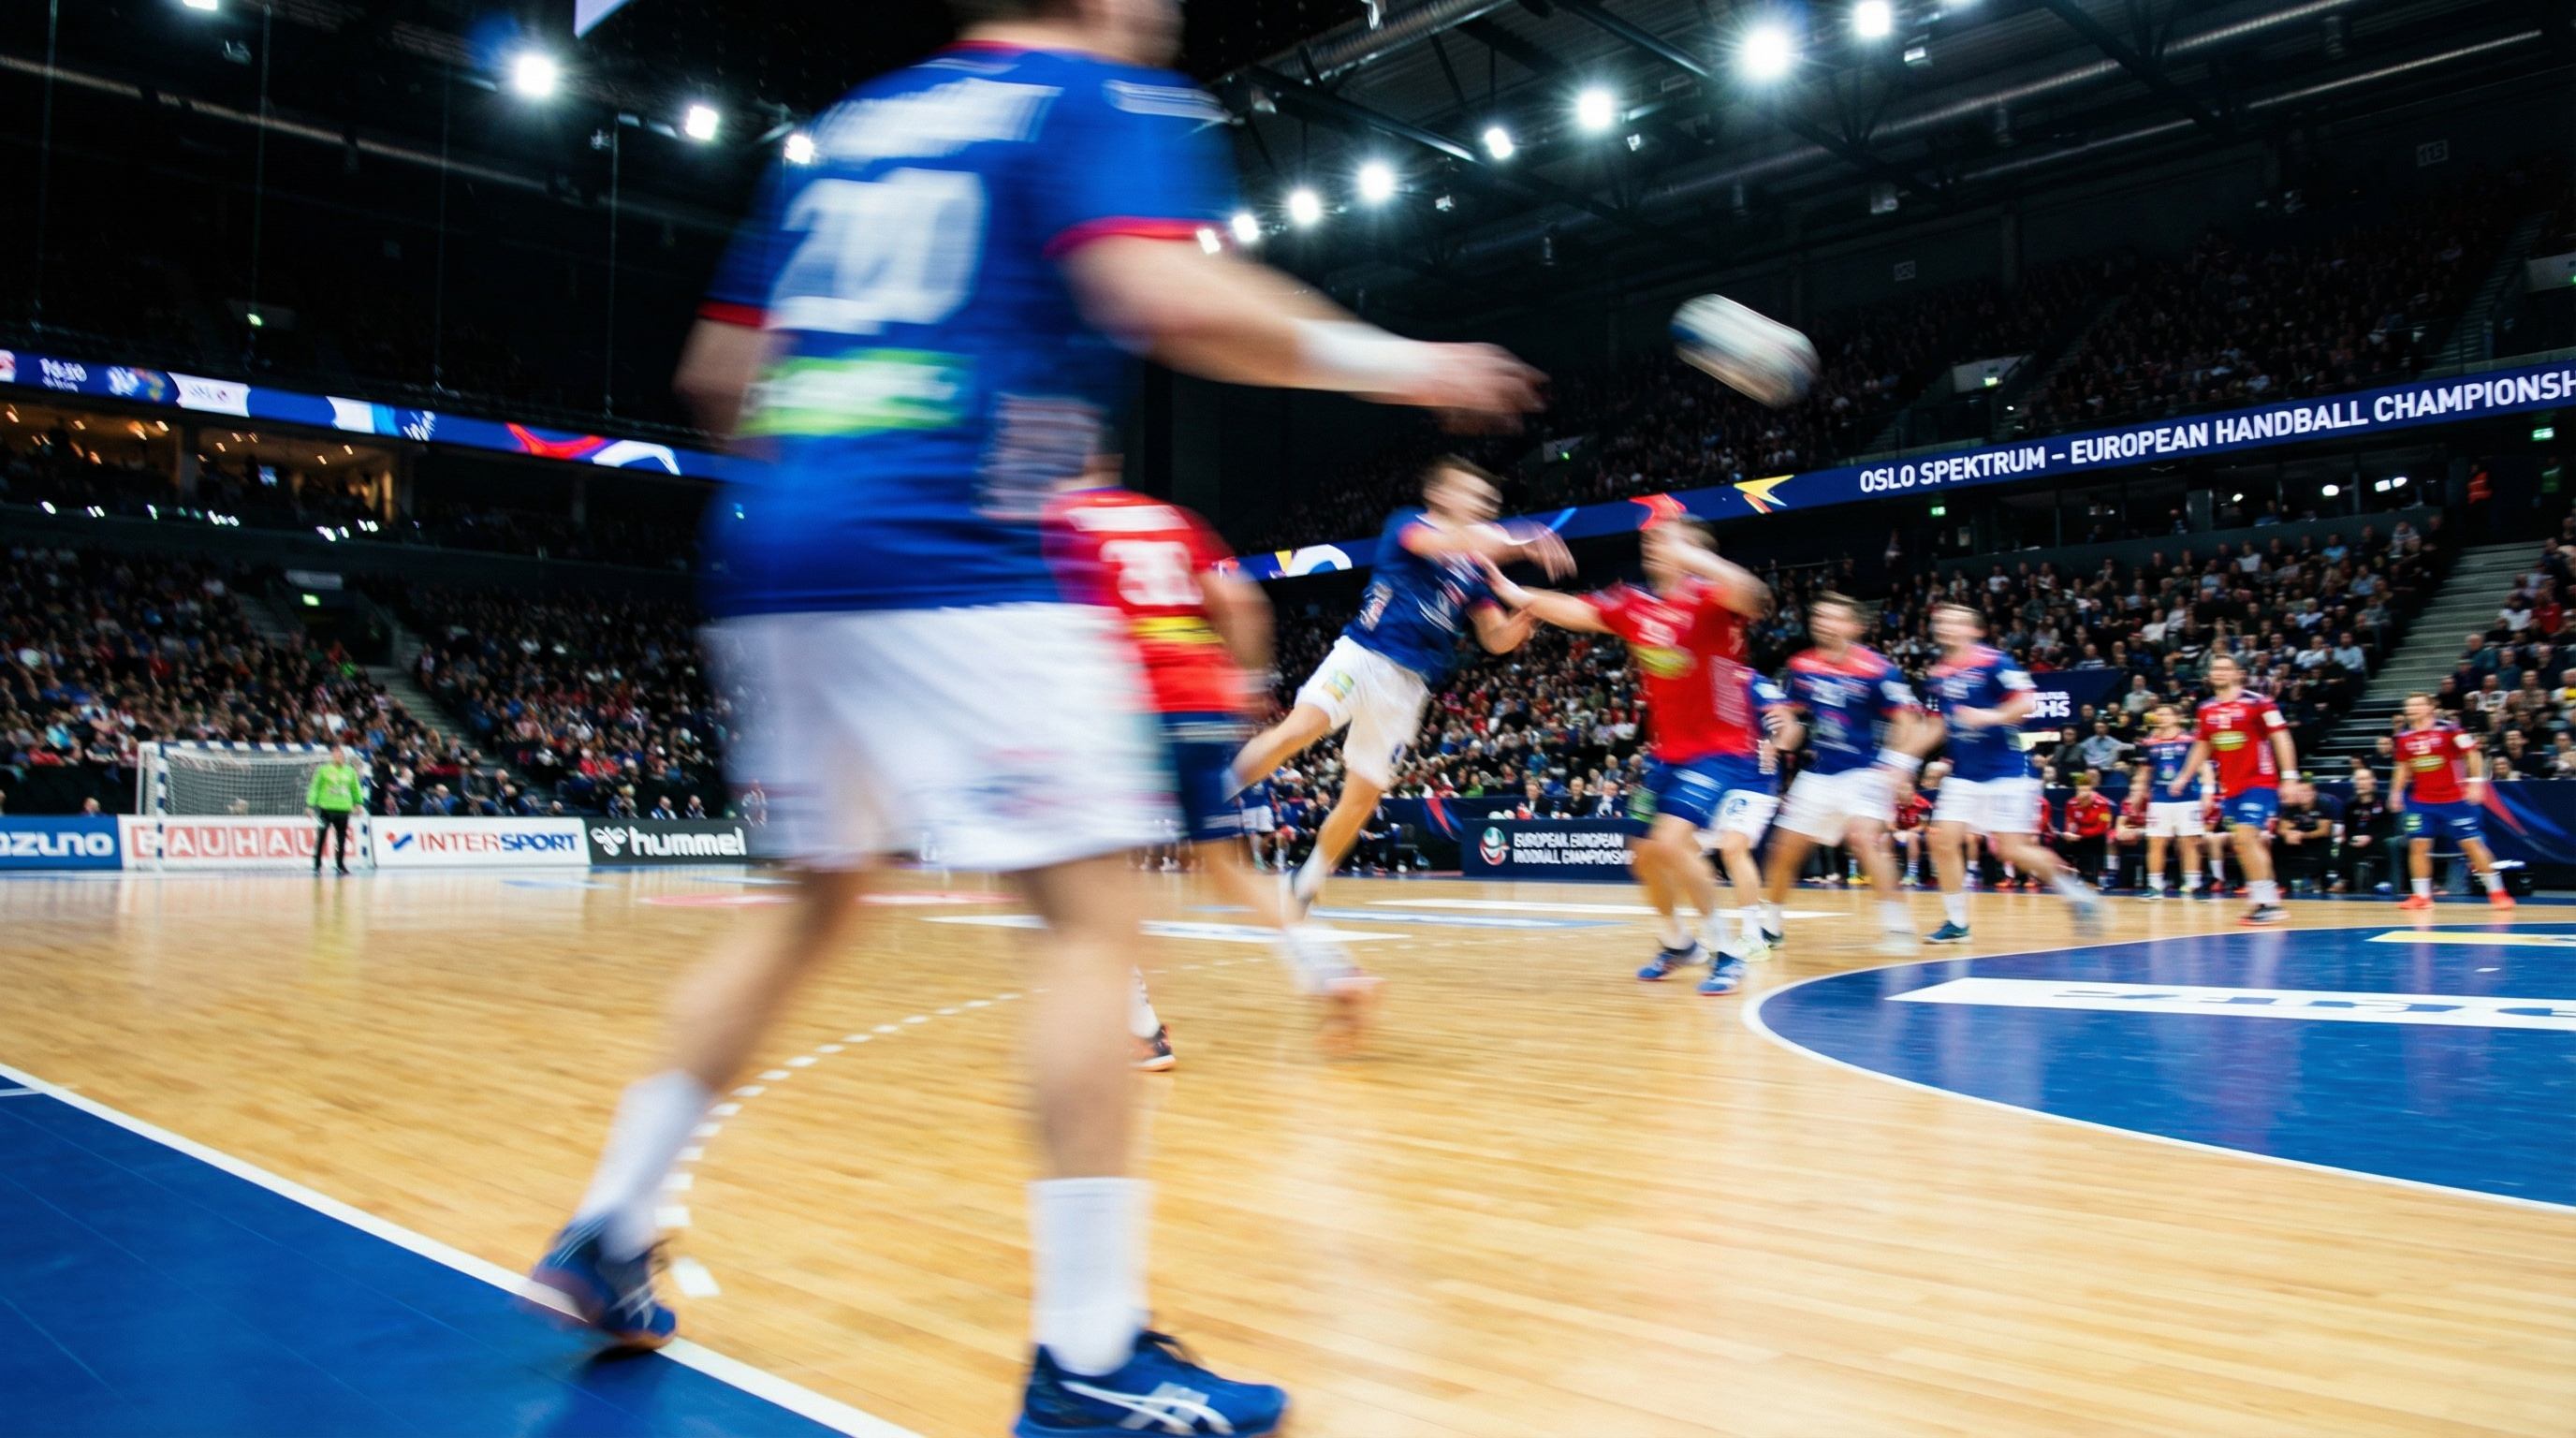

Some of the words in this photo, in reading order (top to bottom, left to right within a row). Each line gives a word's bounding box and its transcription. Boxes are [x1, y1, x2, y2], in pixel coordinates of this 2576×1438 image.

[1860, 464, 1915, 492] OSLO
[1920, 446, 2045, 485] SPEKTRUM
[2071, 421, 2208, 465] EUROPEAN
[2216, 400, 2368, 445] HANDBALL
[419, 831, 578, 853] INTERSPORT
[629, 826, 747, 856] hummel
